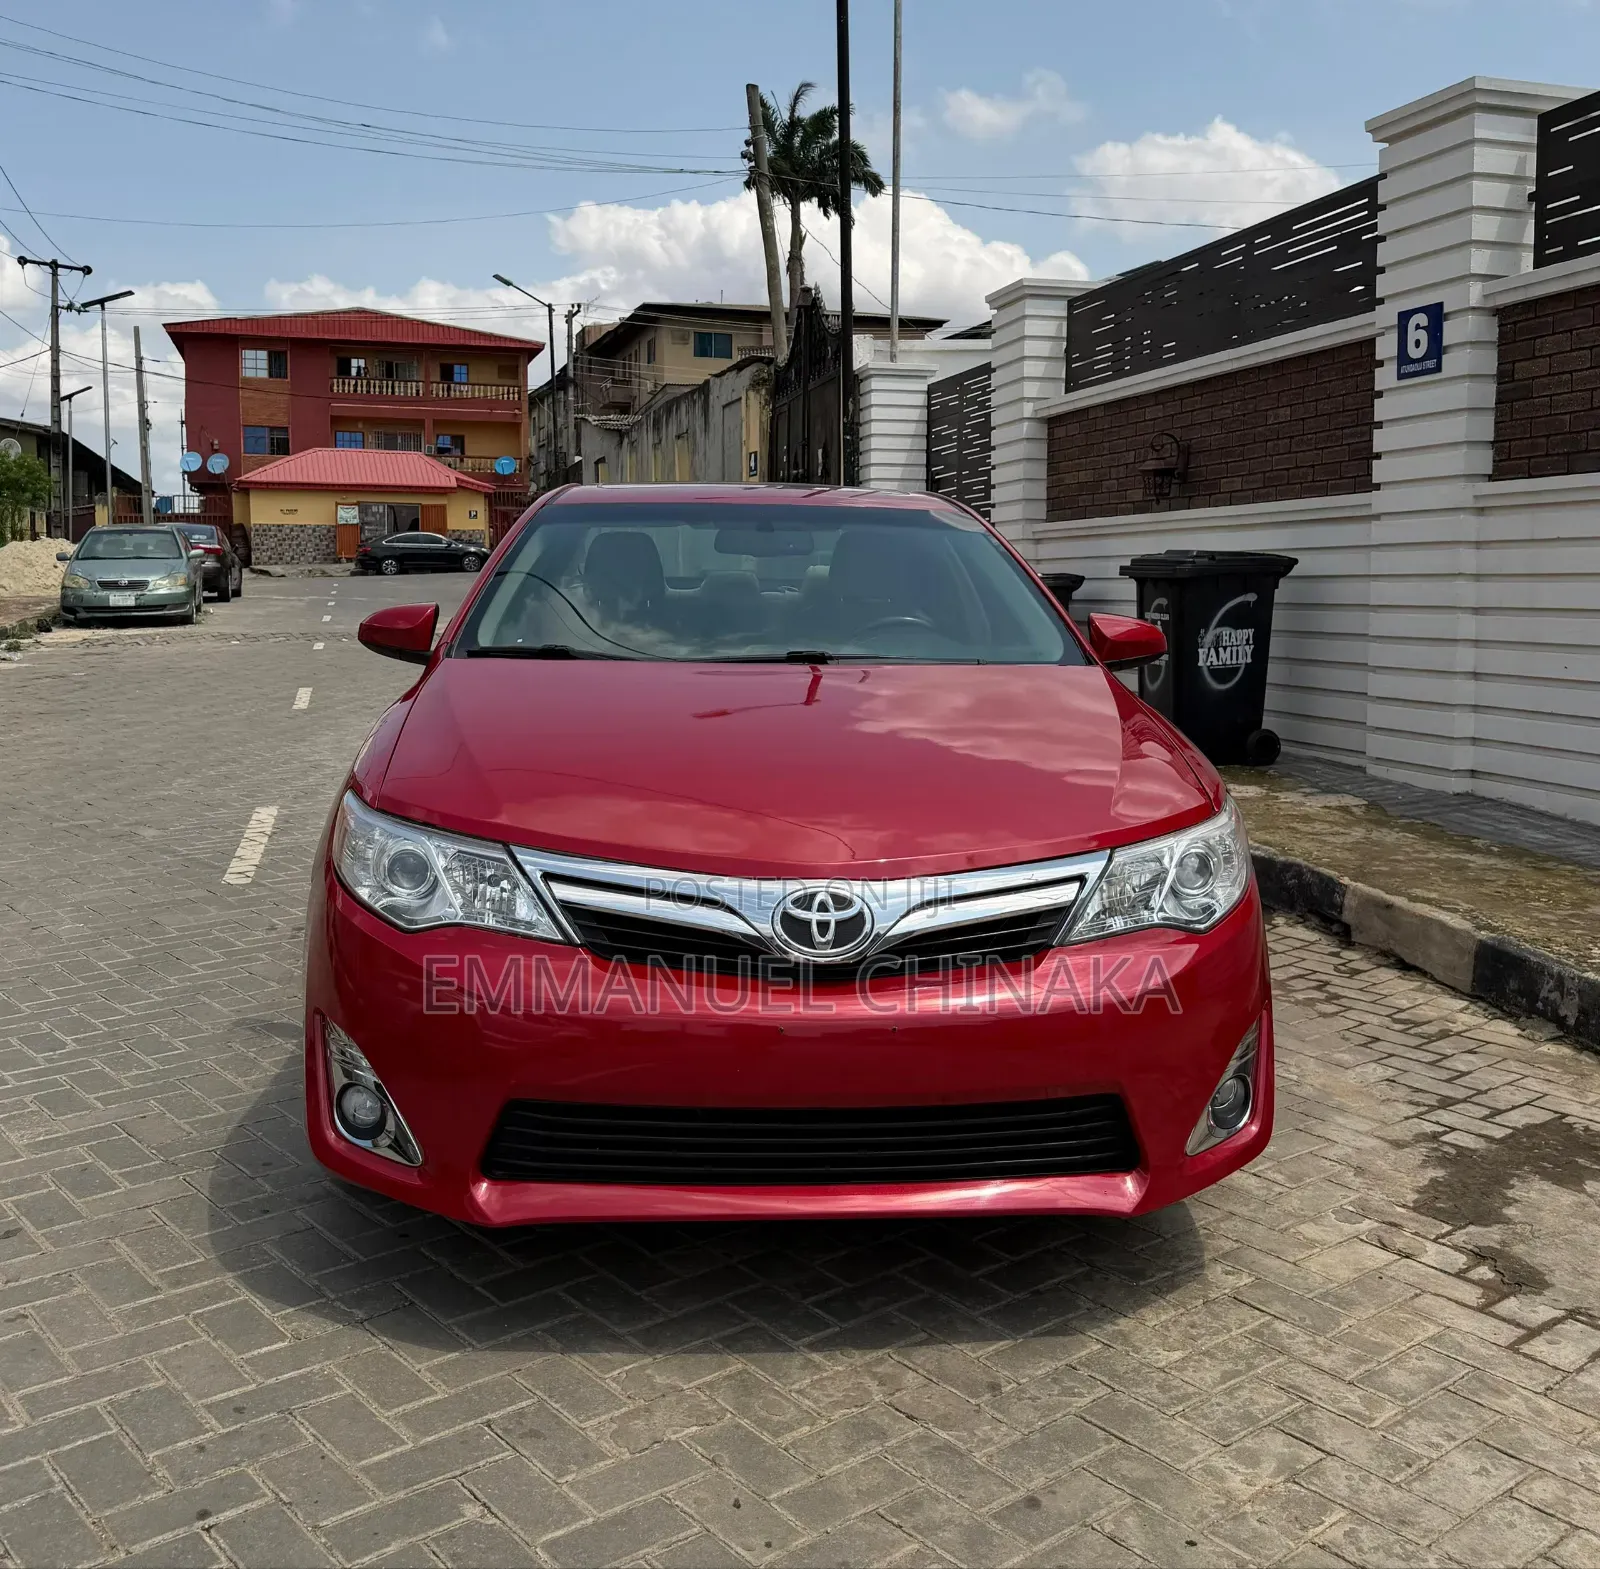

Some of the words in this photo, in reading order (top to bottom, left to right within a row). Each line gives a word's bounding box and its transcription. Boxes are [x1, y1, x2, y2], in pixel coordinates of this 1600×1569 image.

[1407, 312, 1428, 359] 6
[1422, 359, 1437, 370] STREET
[1222, 628, 1255, 646] HAPPY
[1197, 644, 1255, 667] FAMILY
